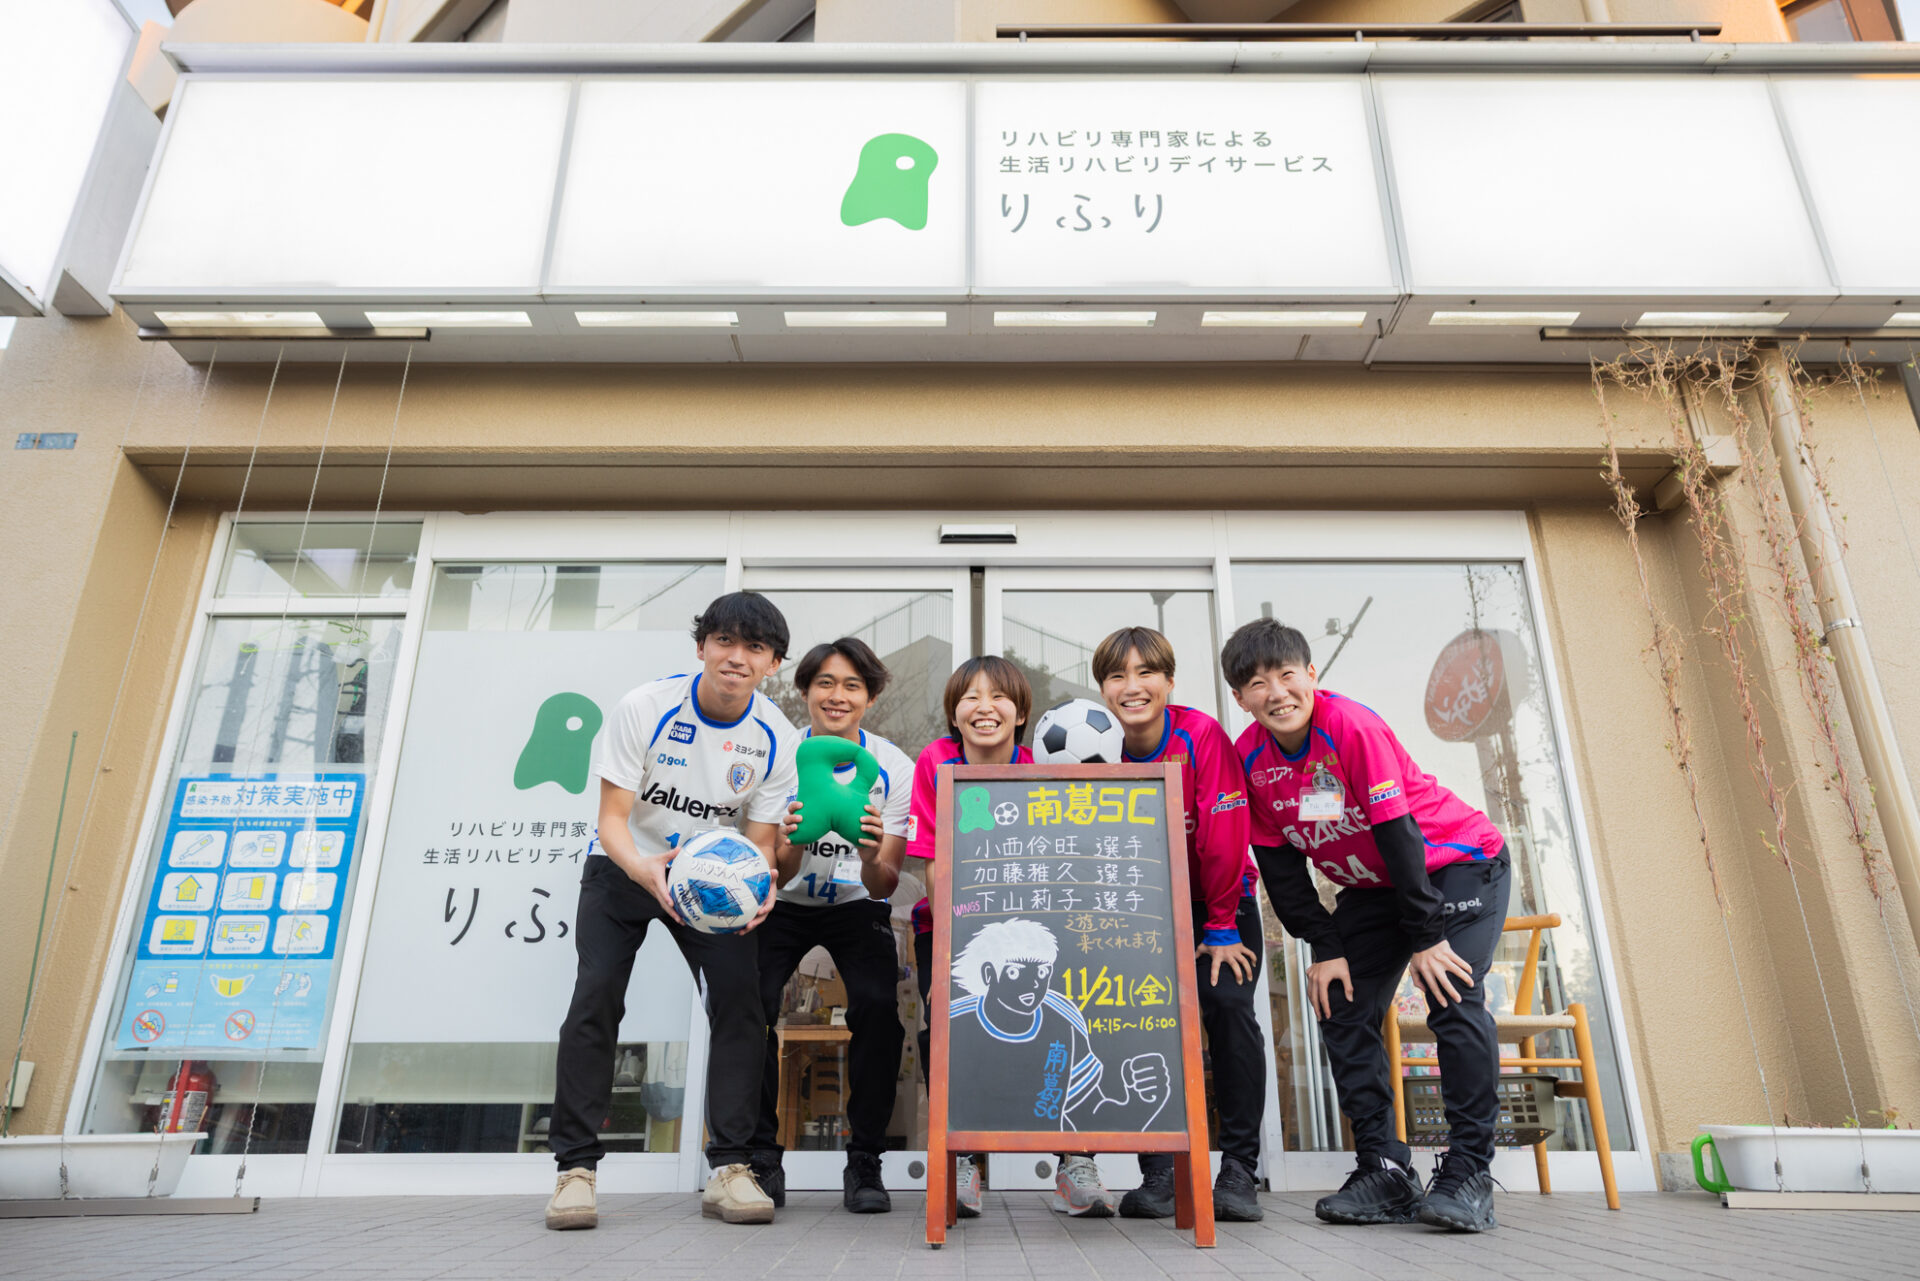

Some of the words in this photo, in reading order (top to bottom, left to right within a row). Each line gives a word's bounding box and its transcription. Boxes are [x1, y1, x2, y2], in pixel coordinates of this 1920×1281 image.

[1001, 130, 1274, 148] リハビリ専門家による
[999, 155, 1334, 174] 生活リハビリデイサービス
[1000, 193, 1164, 233] りふり
[670, 730, 692, 741] OMY
[734, 744, 766, 758] ミヨシ油
[1027, 783, 1158, 826] 南葛SC
[450, 821, 588, 838] リハビリ専門家
[423, 847, 584, 865] 生活リハビリデイ
[975, 836, 1081, 858] 小西伶旺
[1093, 836, 1143, 859] 選手
[974, 862, 1079, 883] 加藤雅久
[1095, 863, 1144, 886] 選手
[1320, 853, 1382, 886] 34
[803, 872, 838, 904] 14
[953, 900, 981, 917] WINGS
[976, 888, 1082, 912] 下山莉子
[1092, 890, 1144, 912] 選手
[444, 887, 569, 946] りふ
[1064, 914, 1129, 933] 遊びに
[1076, 929, 1163, 954] 来てくれます。
